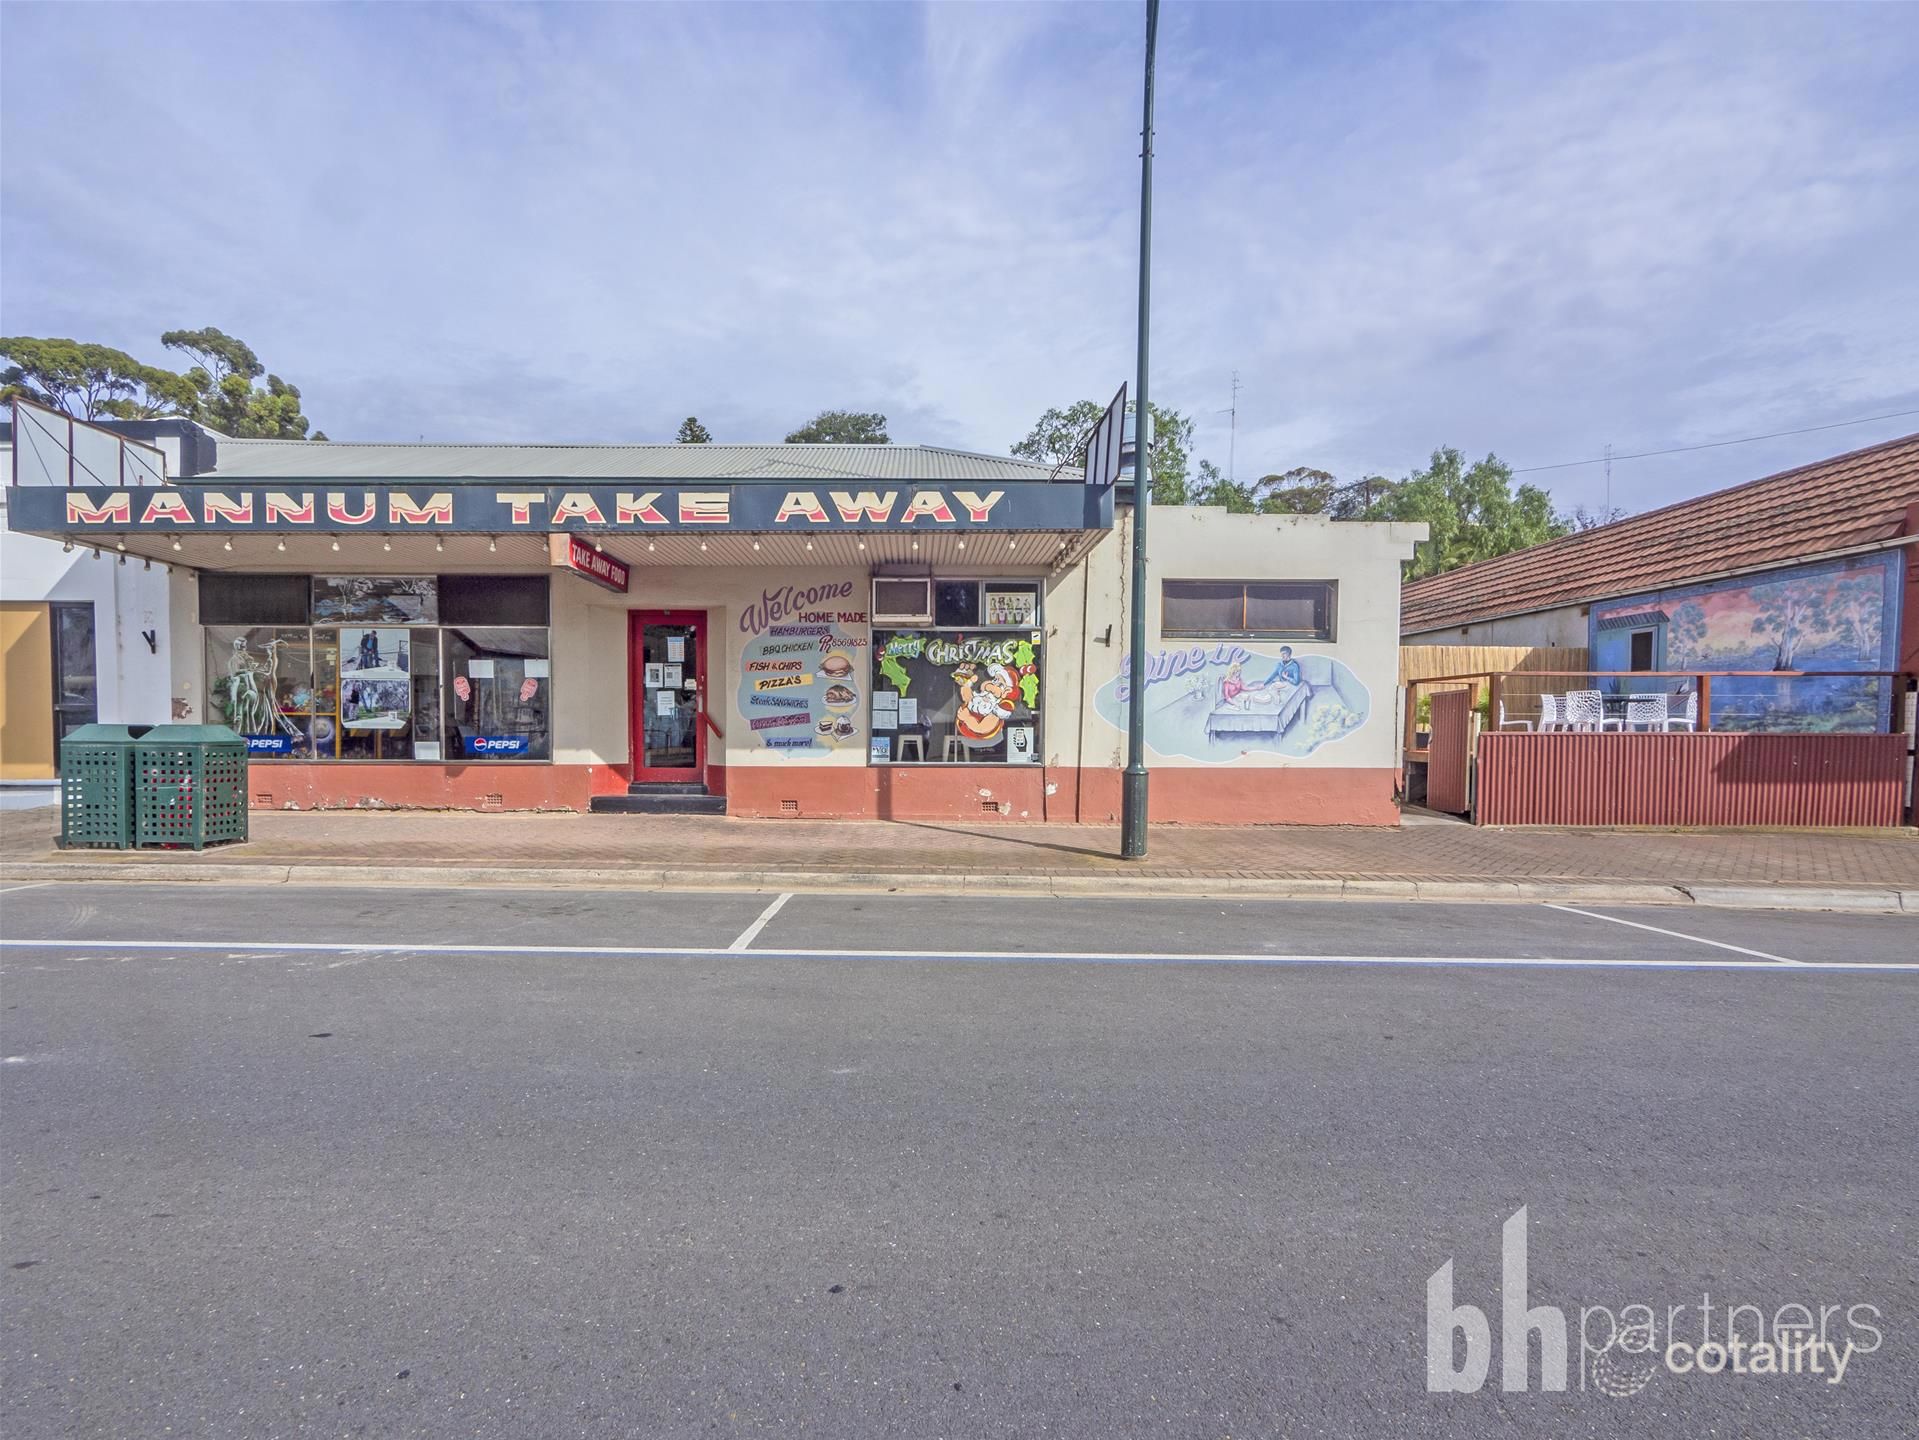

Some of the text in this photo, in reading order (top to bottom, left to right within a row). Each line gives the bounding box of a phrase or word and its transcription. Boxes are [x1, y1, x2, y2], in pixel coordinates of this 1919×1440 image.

[66, 490, 1006, 525] MANNUM TAKE AWAY
[572, 543, 626, 585] TAKE AWAY FOOD
[740, 581, 853, 635] Welcome
[798, 611, 868, 623] HOME MADE
[770, 625, 830, 637] HAMBURGERS
[762, 642, 813, 656] BBQ CHICKEN
[749, 661, 802, 671] FISH & CHIPS
[759, 675, 802, 690] PIZZA'S
[251, 739, 283, 748] PEPSI
[488, 740, 520, 749] PEPSI
